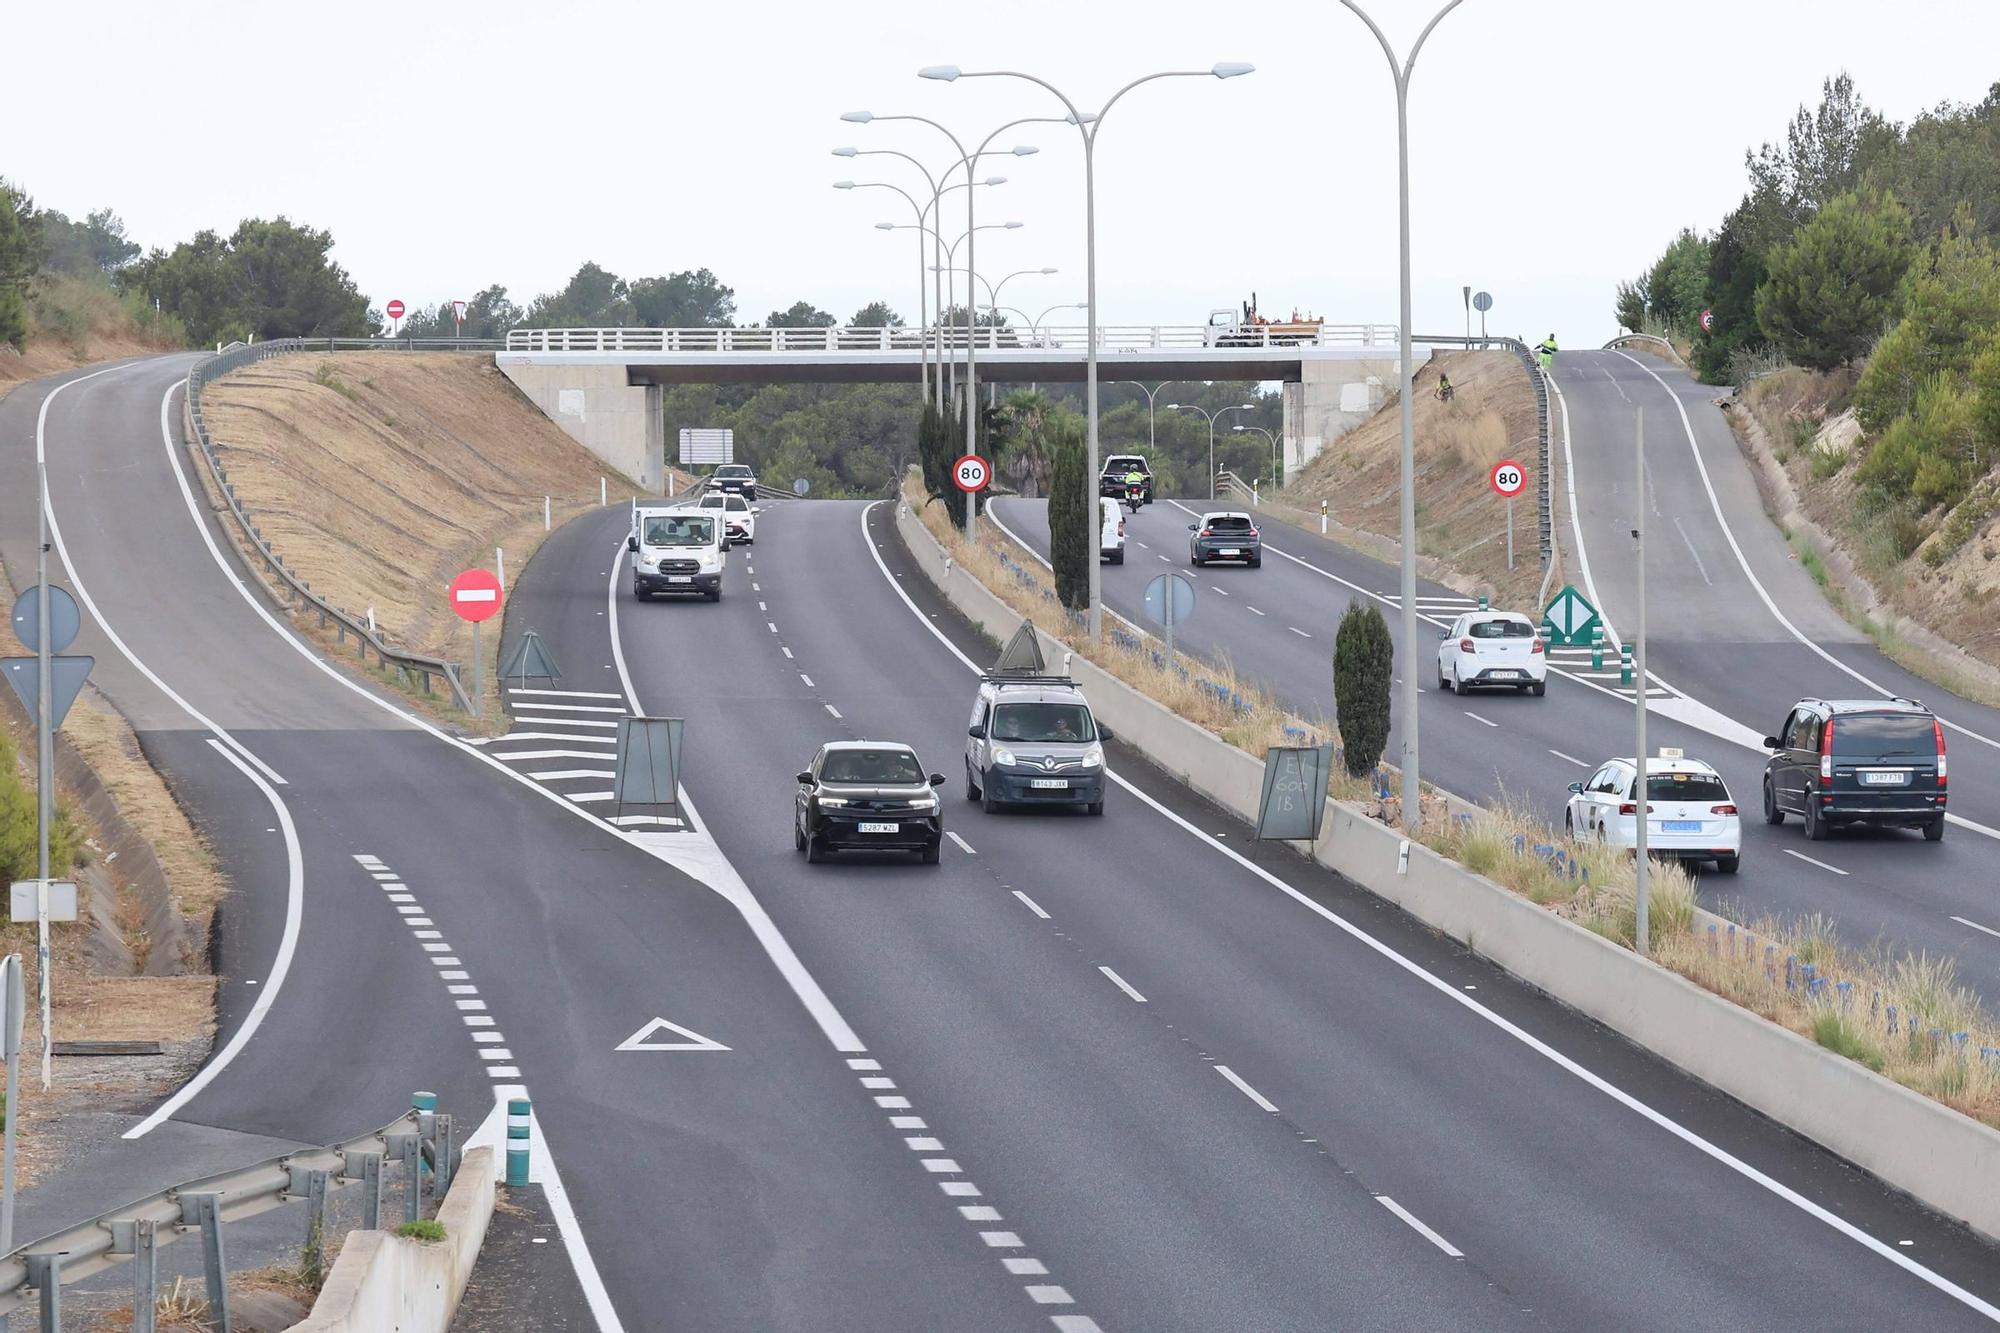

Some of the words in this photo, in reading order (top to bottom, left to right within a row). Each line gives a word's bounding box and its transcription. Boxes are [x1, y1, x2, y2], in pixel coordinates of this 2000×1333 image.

[961, 467, 982, 480] 80
[1499, 472, 1519, 484] 80
[863, 824, 881, 832] 5287
